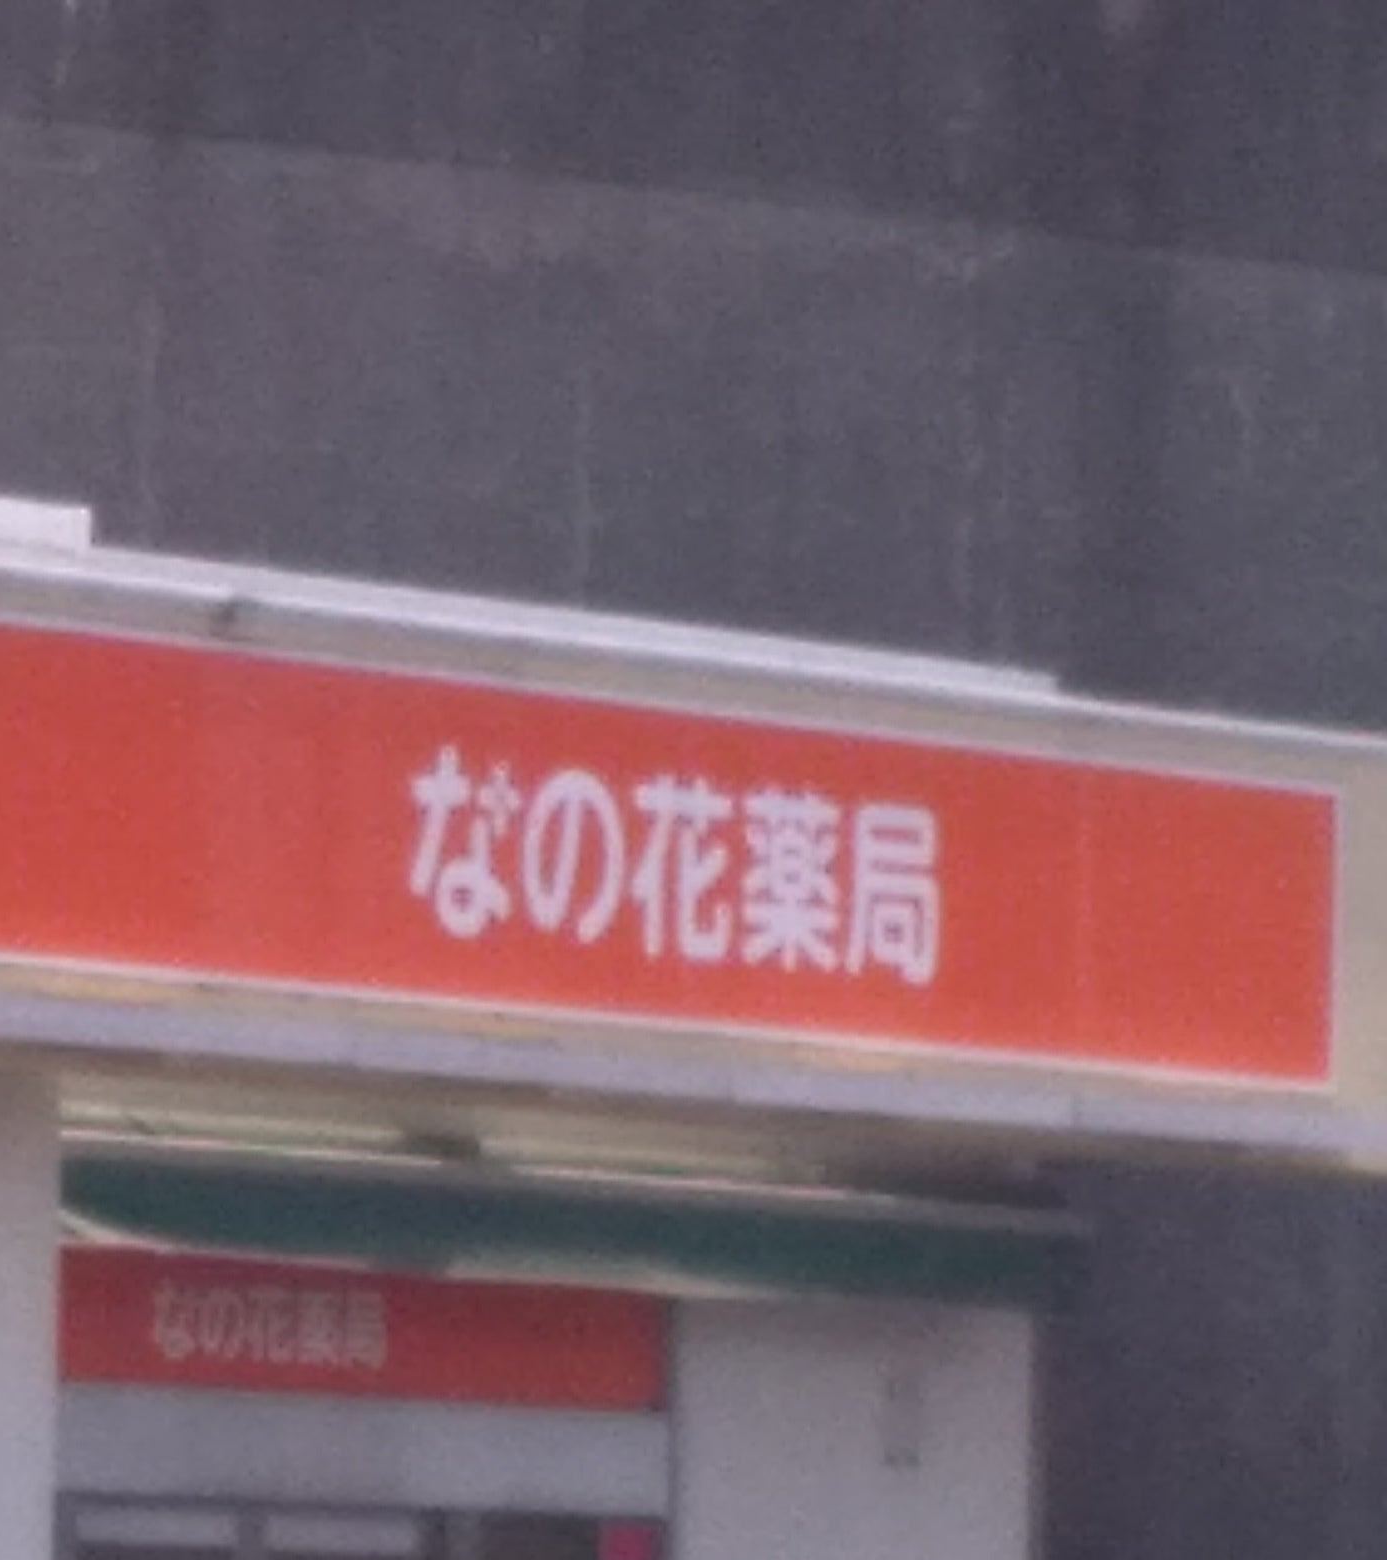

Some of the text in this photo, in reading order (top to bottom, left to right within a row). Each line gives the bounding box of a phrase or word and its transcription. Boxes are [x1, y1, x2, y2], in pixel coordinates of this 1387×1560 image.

[409, 744, 941, 986] なの花薬局
[152, 1279, 387, 1371] なの花薬局
